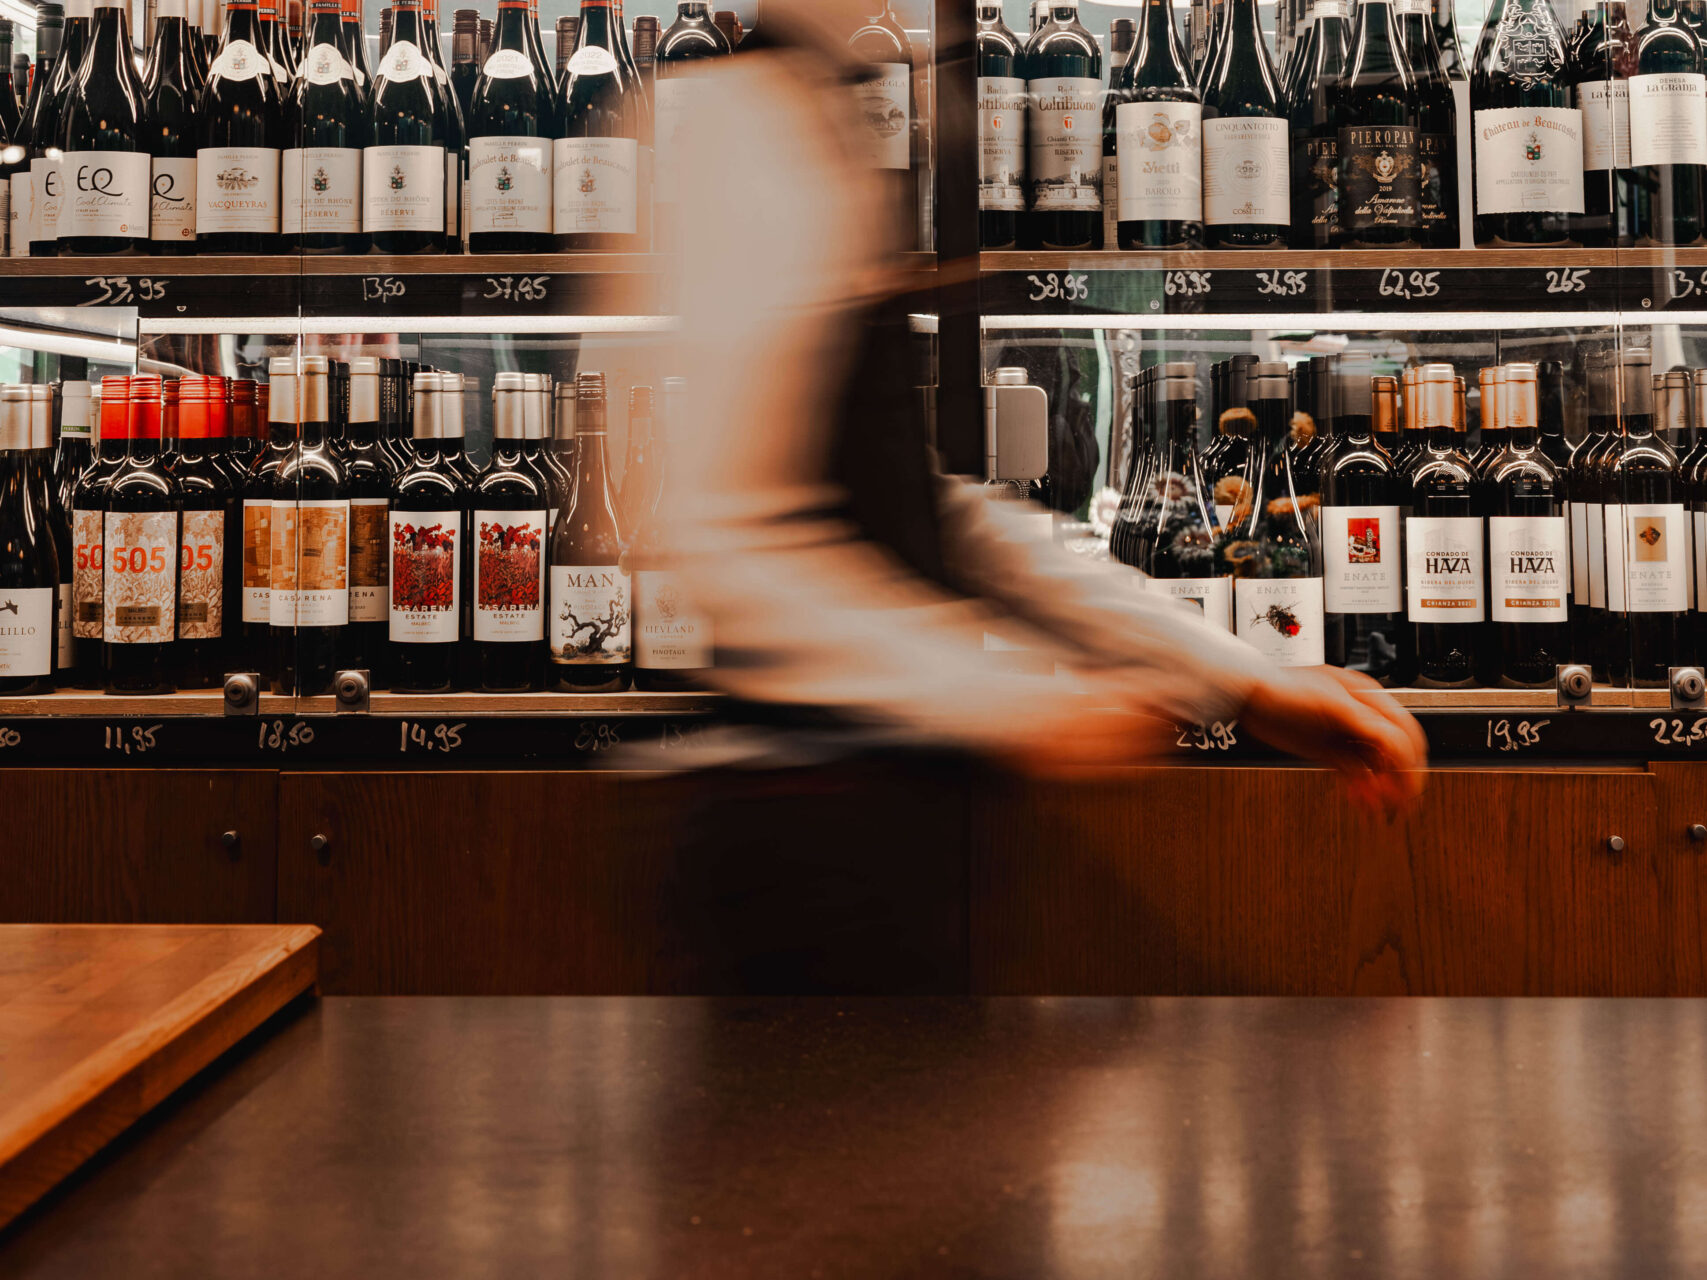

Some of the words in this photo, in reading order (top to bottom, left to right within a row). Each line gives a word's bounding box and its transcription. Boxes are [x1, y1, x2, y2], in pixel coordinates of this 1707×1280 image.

[1659, 77, 1687, 85] DEHESA
[978, 96, 1024, 112] oltibuono
[1038, 96, 1097, 112] Coltibuono
[1483, 120, 1520, 141] Château
[1534, 115, 1577, 141] Beaucastel
[1350, 130, 1416, 145] PIEROPAN
[1306, 142, 1338, 157] PIER
[1141, 161, 1180, 176] Vietti
[77, 165, 124, 197] EQ
[1378, 185, 1393, 193] 2019
[1145, 186, 1181, 196] BAROLO
[208, 199, 268, 210] VACQUEYRAS
[1364, 193, 1406, 206] Amarone
[380, 208, 417, 217] RÉSERVE
[1027, 273, 1089, 301] 38,95
[1165, 271, 1212, 297] 69,95
[1255, 269, 1308, 297] 36,95
[1378, 269, 1441, 300] 62,95
[1545, 268, 1591, 294] 265
[75, 277, 170, 308] 33,95
[362, 277, 406, 304] 13,50
[77, 543, 104, 571] 50
[112, 546, 167, 574] 505
[181, 544, 214, 571] 05
[1425, 557, 1471, 574] HAZA
[1510, 557, 1555, 574] HAZA
[1343, 572, 1386, 582] ENATE
[1629, 570, 1672, 580] ENATE
[1170, 586, 1210, 595] ENATE
[1256, 586, 1297, 595] ENATE
[391, 603, 454, 613] CASARENA
[477, 603, 540, 612] CASARENA
[1510, 599, 1540, 607] CRIANZA
[104, 724, 164, 755] 11,95
[258, 720, 315, 752] 18,50
[1648, 717, 1707, 747] 22,5
